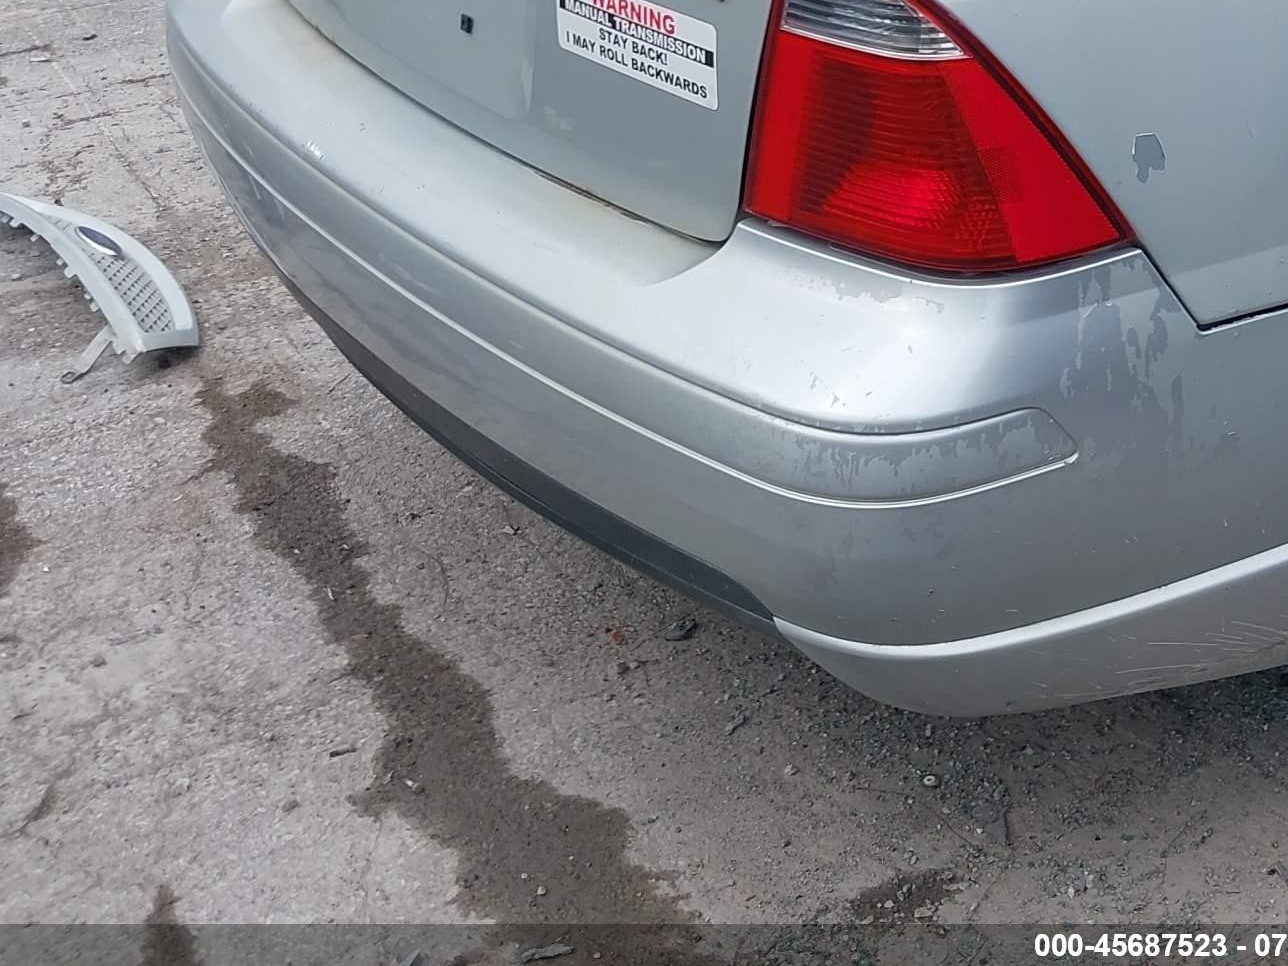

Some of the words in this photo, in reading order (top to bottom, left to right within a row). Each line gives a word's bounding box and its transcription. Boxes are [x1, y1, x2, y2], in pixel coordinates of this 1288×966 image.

[599, 28, 628, 50] STAY
[631, 41, 668, 66] BACK!
[613, 16, 706, 63] TRANSMISSION
[566, 30, 570, 43] I
[573, 33, 597, 53] MAY
[600, 46, 629, 67] ROLL
[631, 57, 708, 99] BACKWARDS
